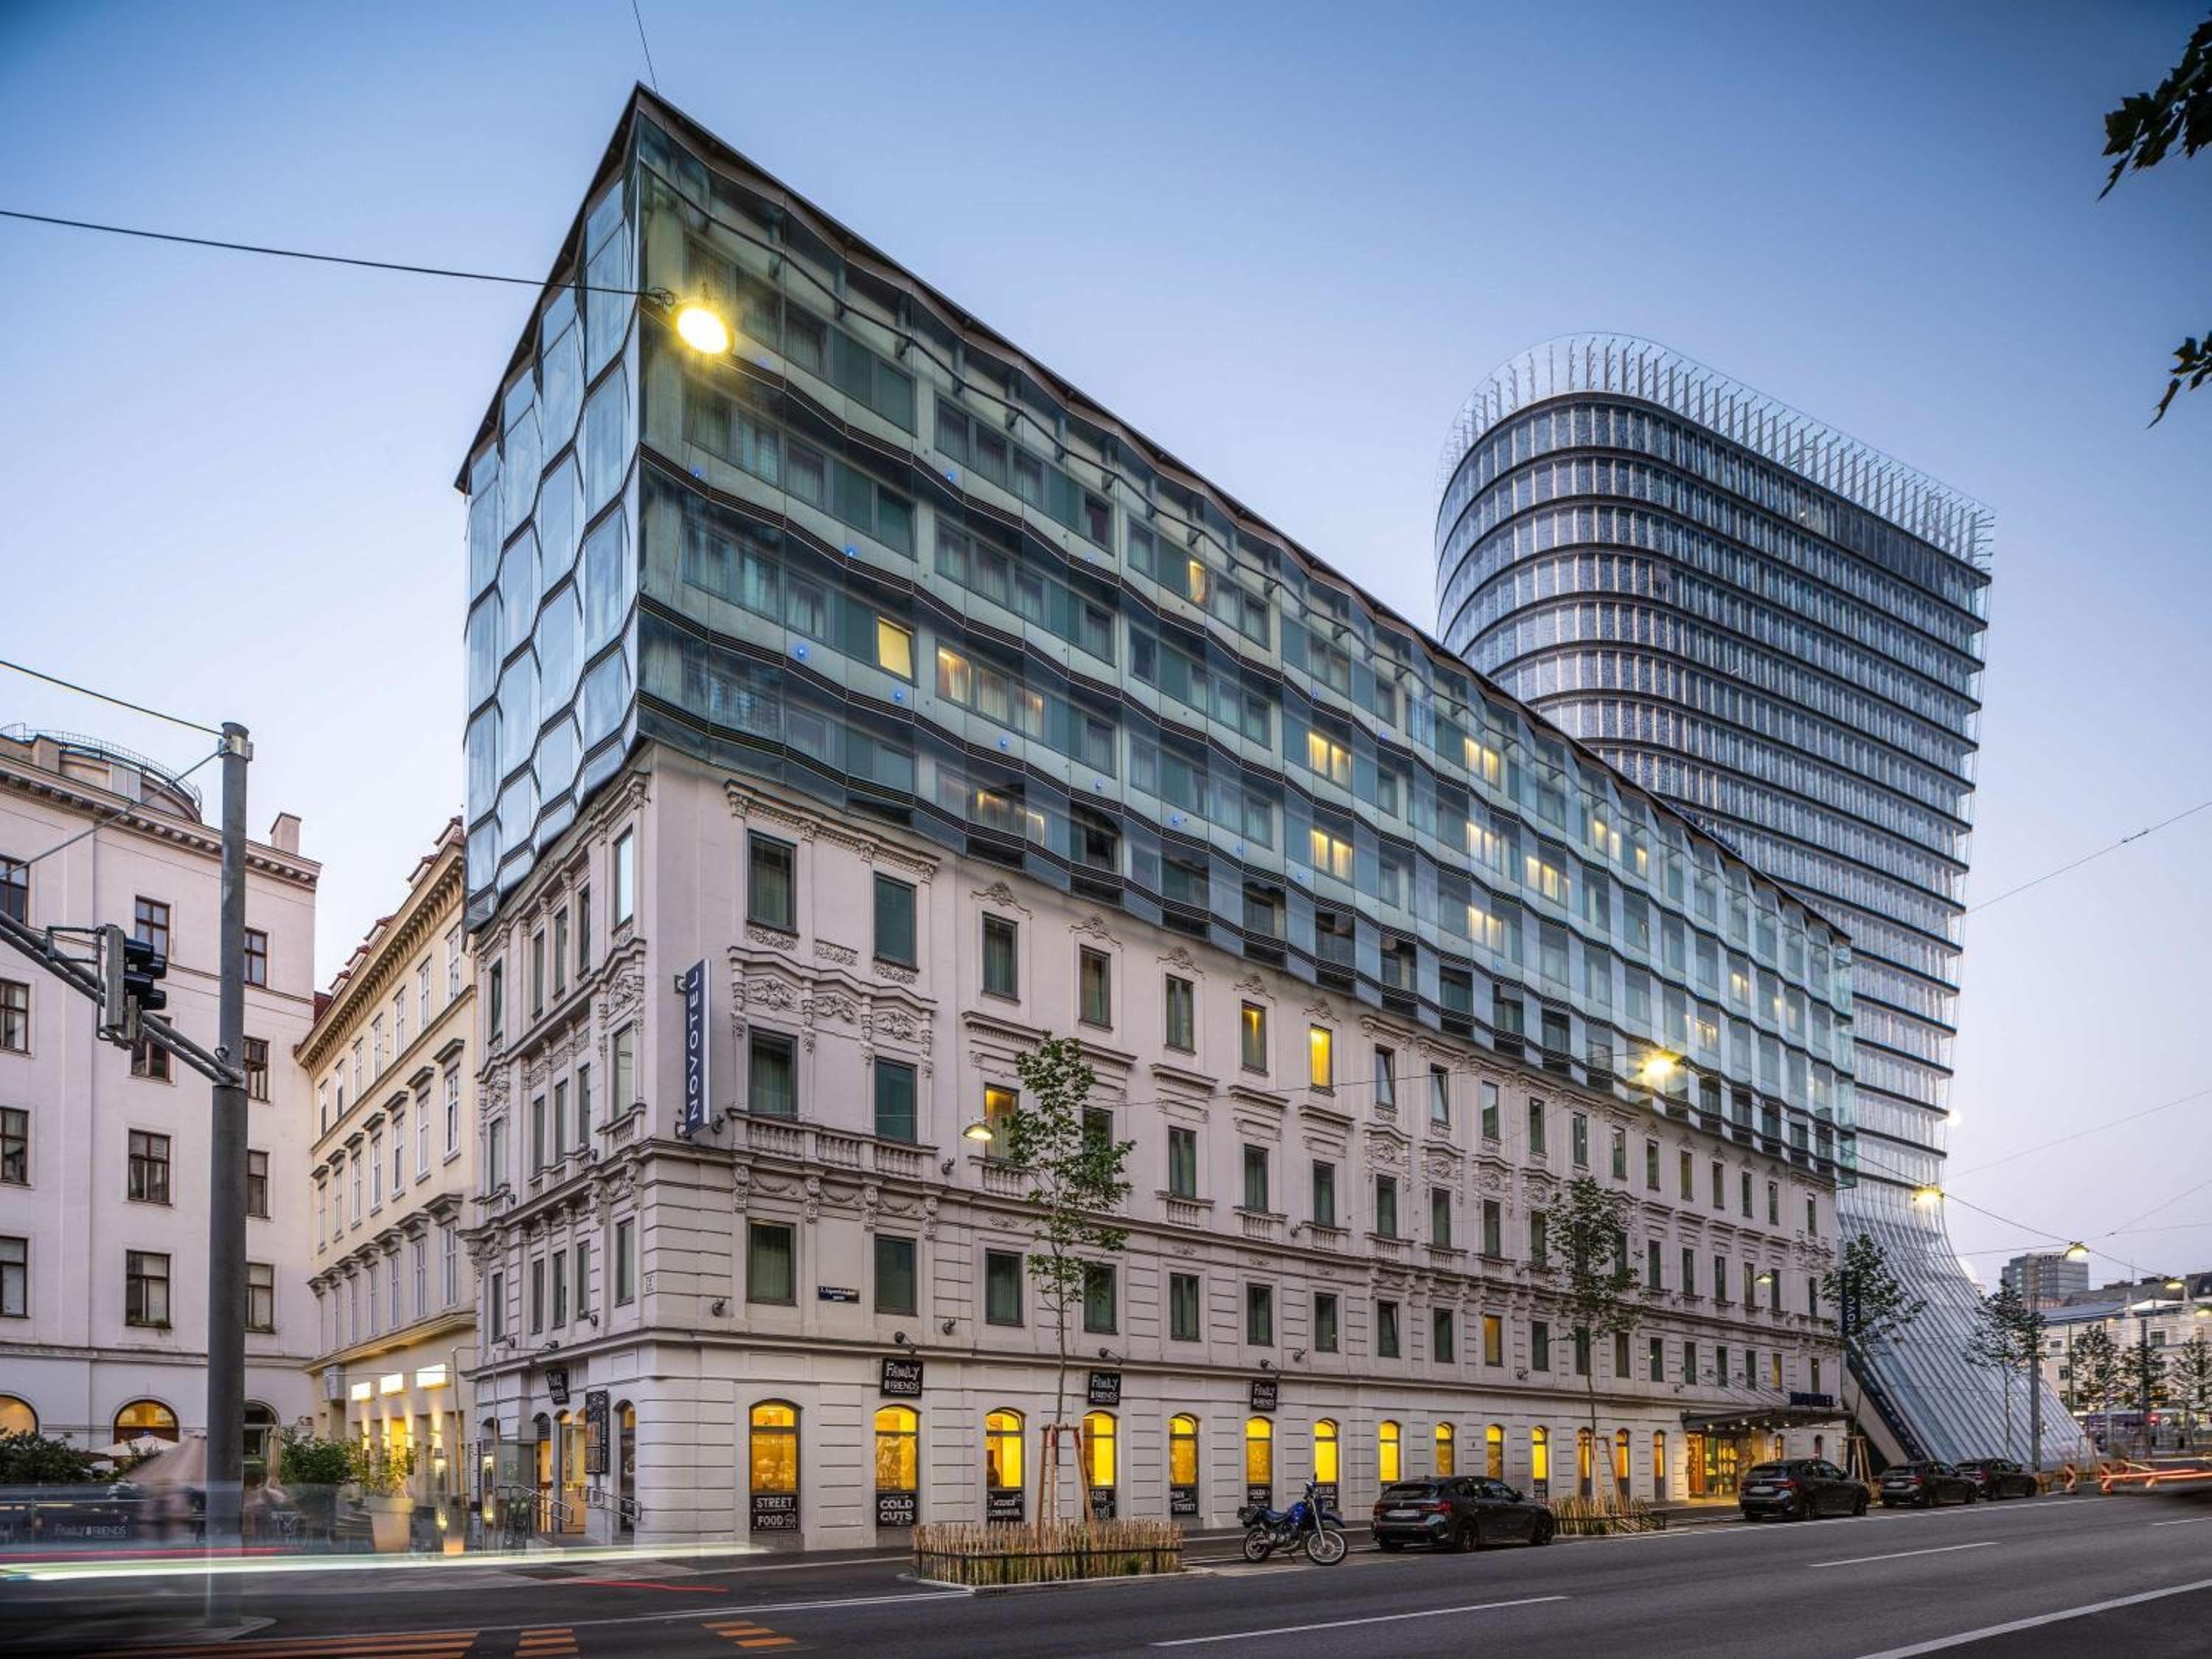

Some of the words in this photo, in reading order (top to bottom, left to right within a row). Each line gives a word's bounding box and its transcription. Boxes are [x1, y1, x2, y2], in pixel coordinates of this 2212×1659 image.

[689, 970, 699, 1121] NOVOTEL
[886, 1362, 921, 1381] FAMILY
[890, 1380, 919, 1391] FRIENDS
[756, 1497, 793, 1509] STREET
[880, 1498, 914, 1510] COLD
[757, 1514, 784, 1527] FOOD
[880, 1511, 914, 1521] CUTS
